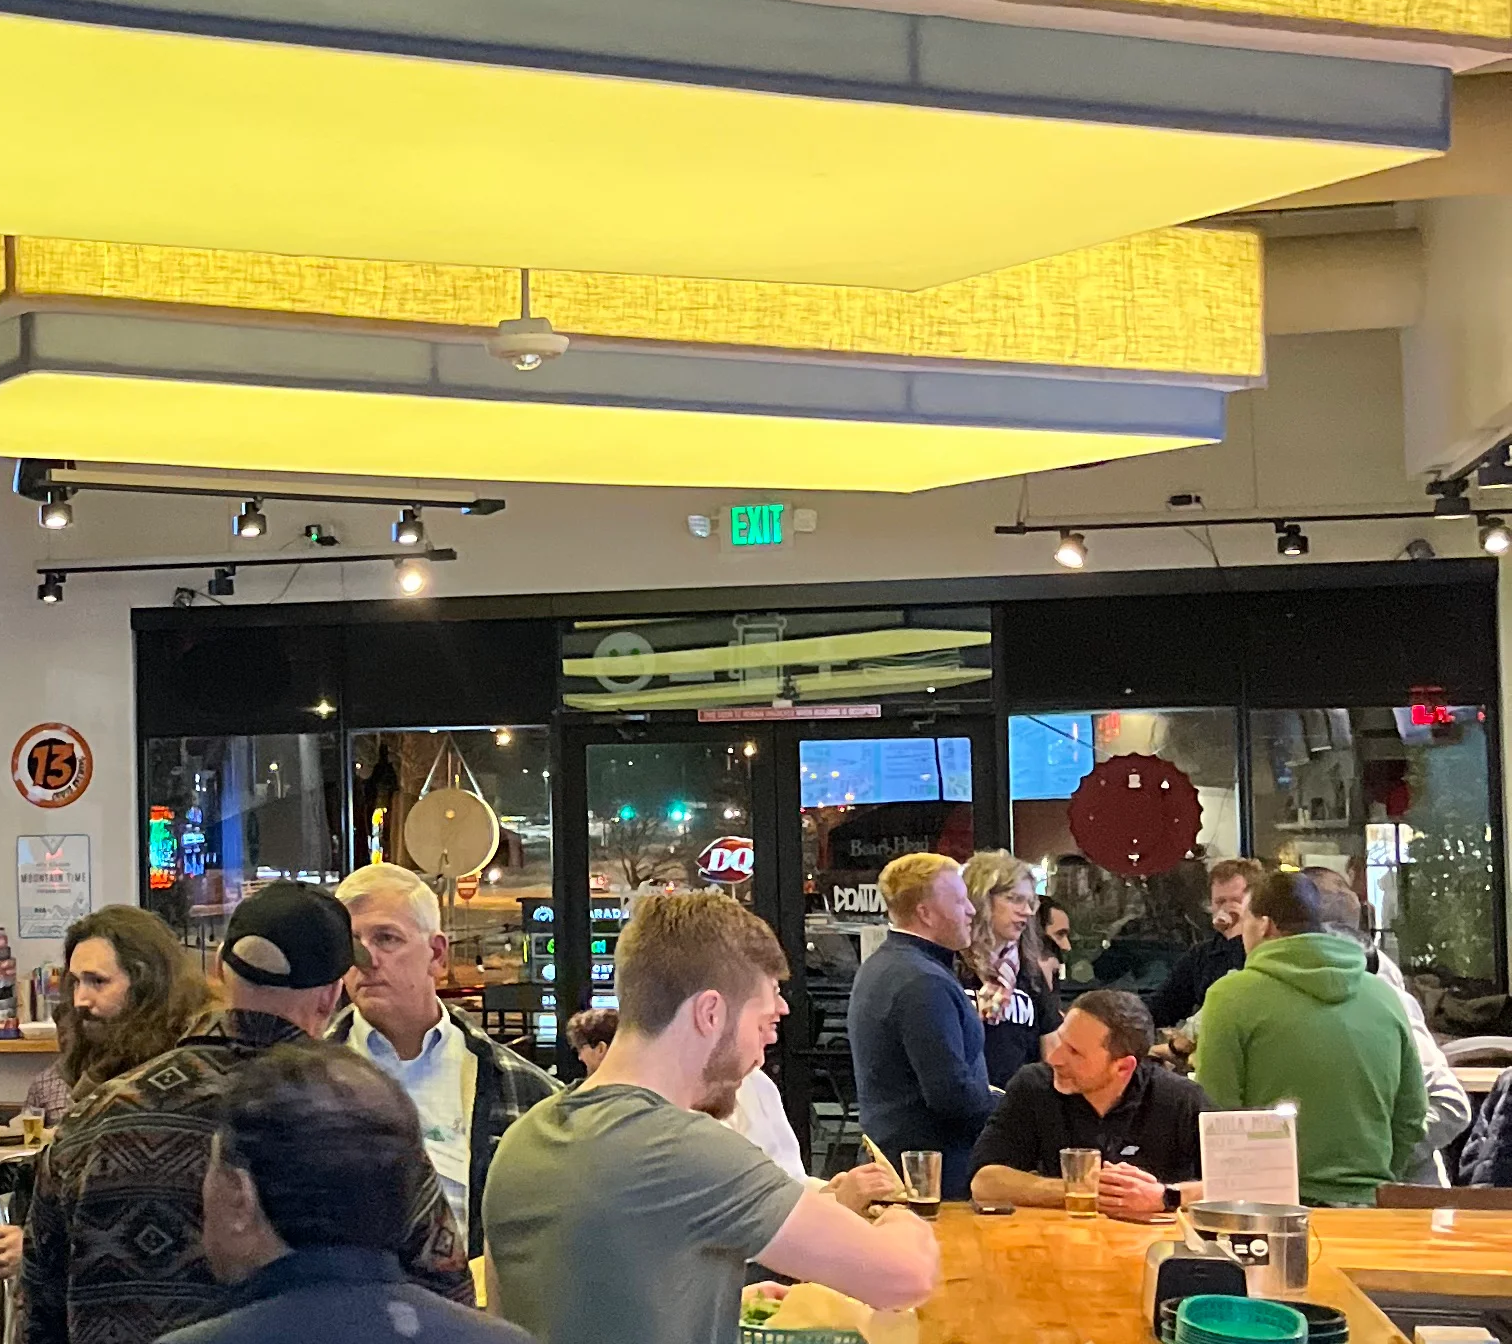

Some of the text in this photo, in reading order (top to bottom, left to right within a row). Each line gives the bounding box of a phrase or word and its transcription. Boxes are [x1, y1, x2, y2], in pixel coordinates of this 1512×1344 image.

[731, 504, 784, 545] EXIT
[32, 742, 75, 788] 13
[893, 834, 929, 853] Head
[707, 847, 754, 875] DQ
[20, 871, 86, 884] MOUNTAIN TIME
